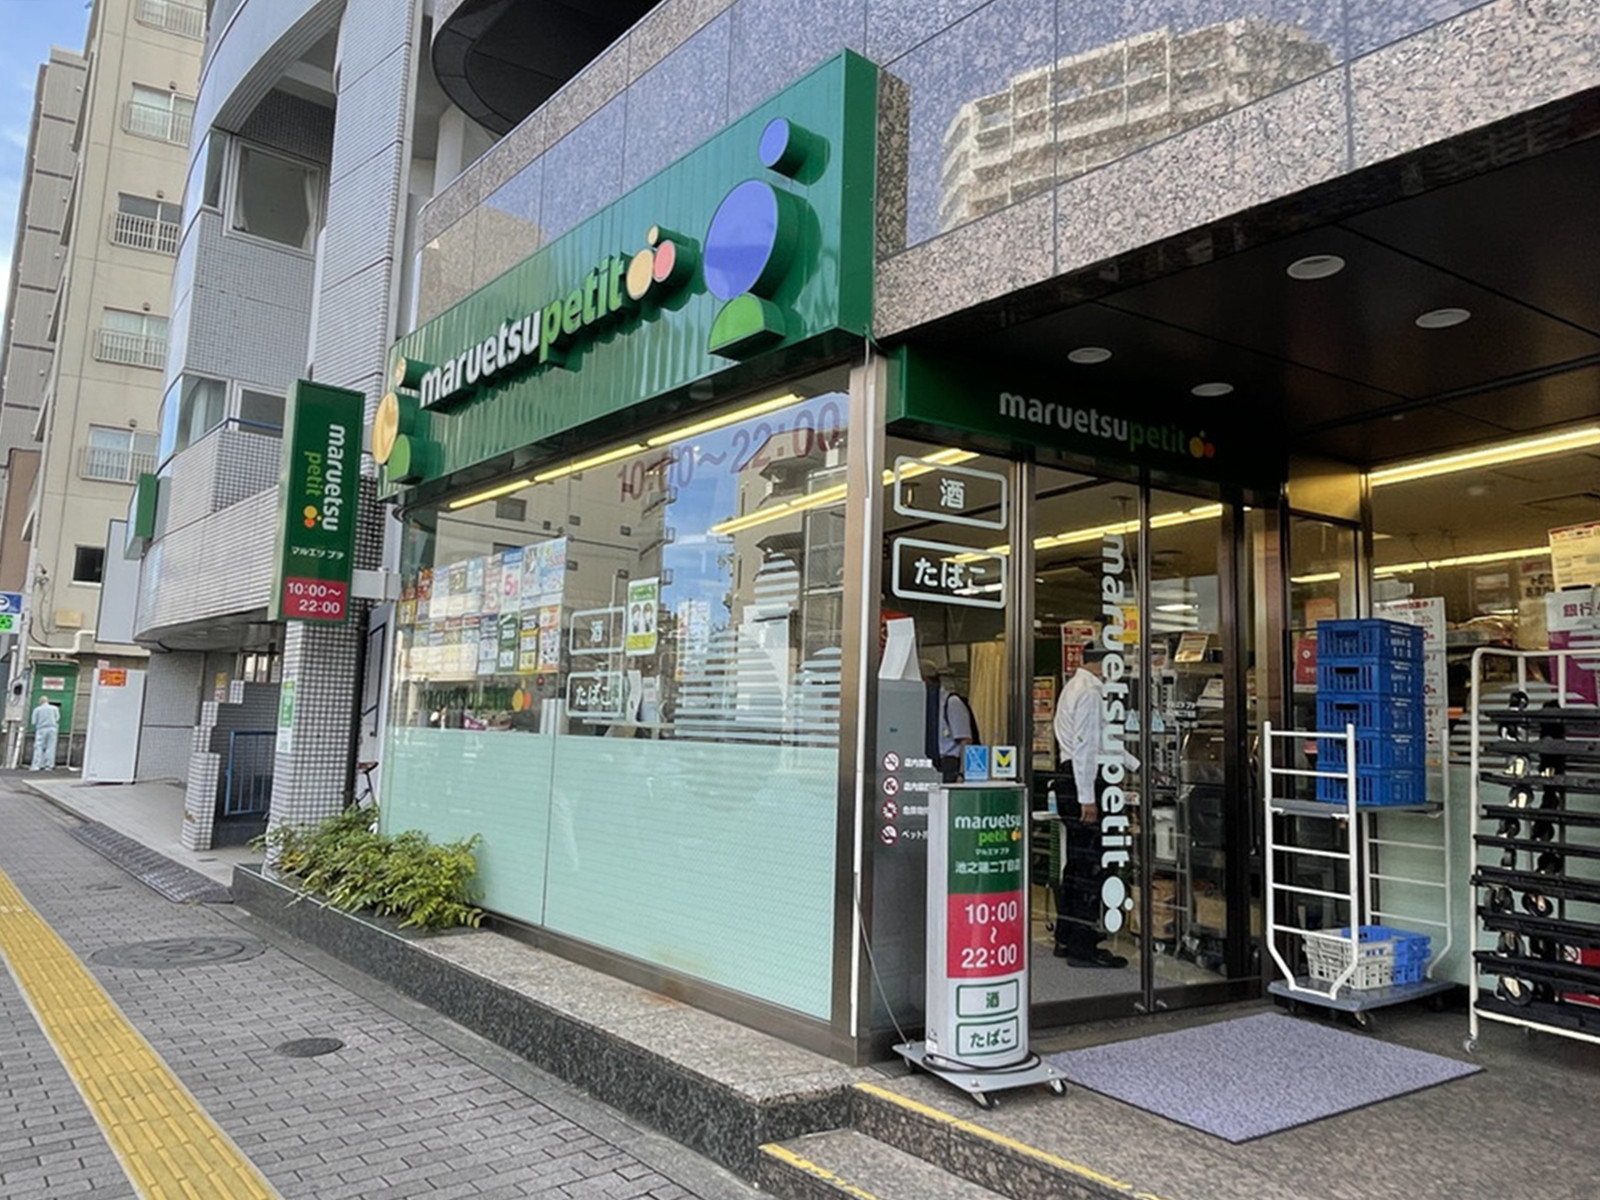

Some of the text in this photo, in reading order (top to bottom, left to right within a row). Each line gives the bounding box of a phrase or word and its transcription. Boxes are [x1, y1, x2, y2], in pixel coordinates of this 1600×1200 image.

[304, 450, 323, 496] petit
[322, 424, 346, 531] maruetsu
[940, 478, 965, 509] 酒
[914, 557, 986, 592] たばこ
[299, 599, 340, 614] 22:00
[1563, 601, 1600, 618] 銀行
[955, 814, 1021, 829] maruetsu
[965, 901, 1017, 924] 10:00
[961, 944, 1017, 968] 22:00
[986, 991, 1000, 1008] 酒
[970, 1029, 1012, 1048] たばこ
